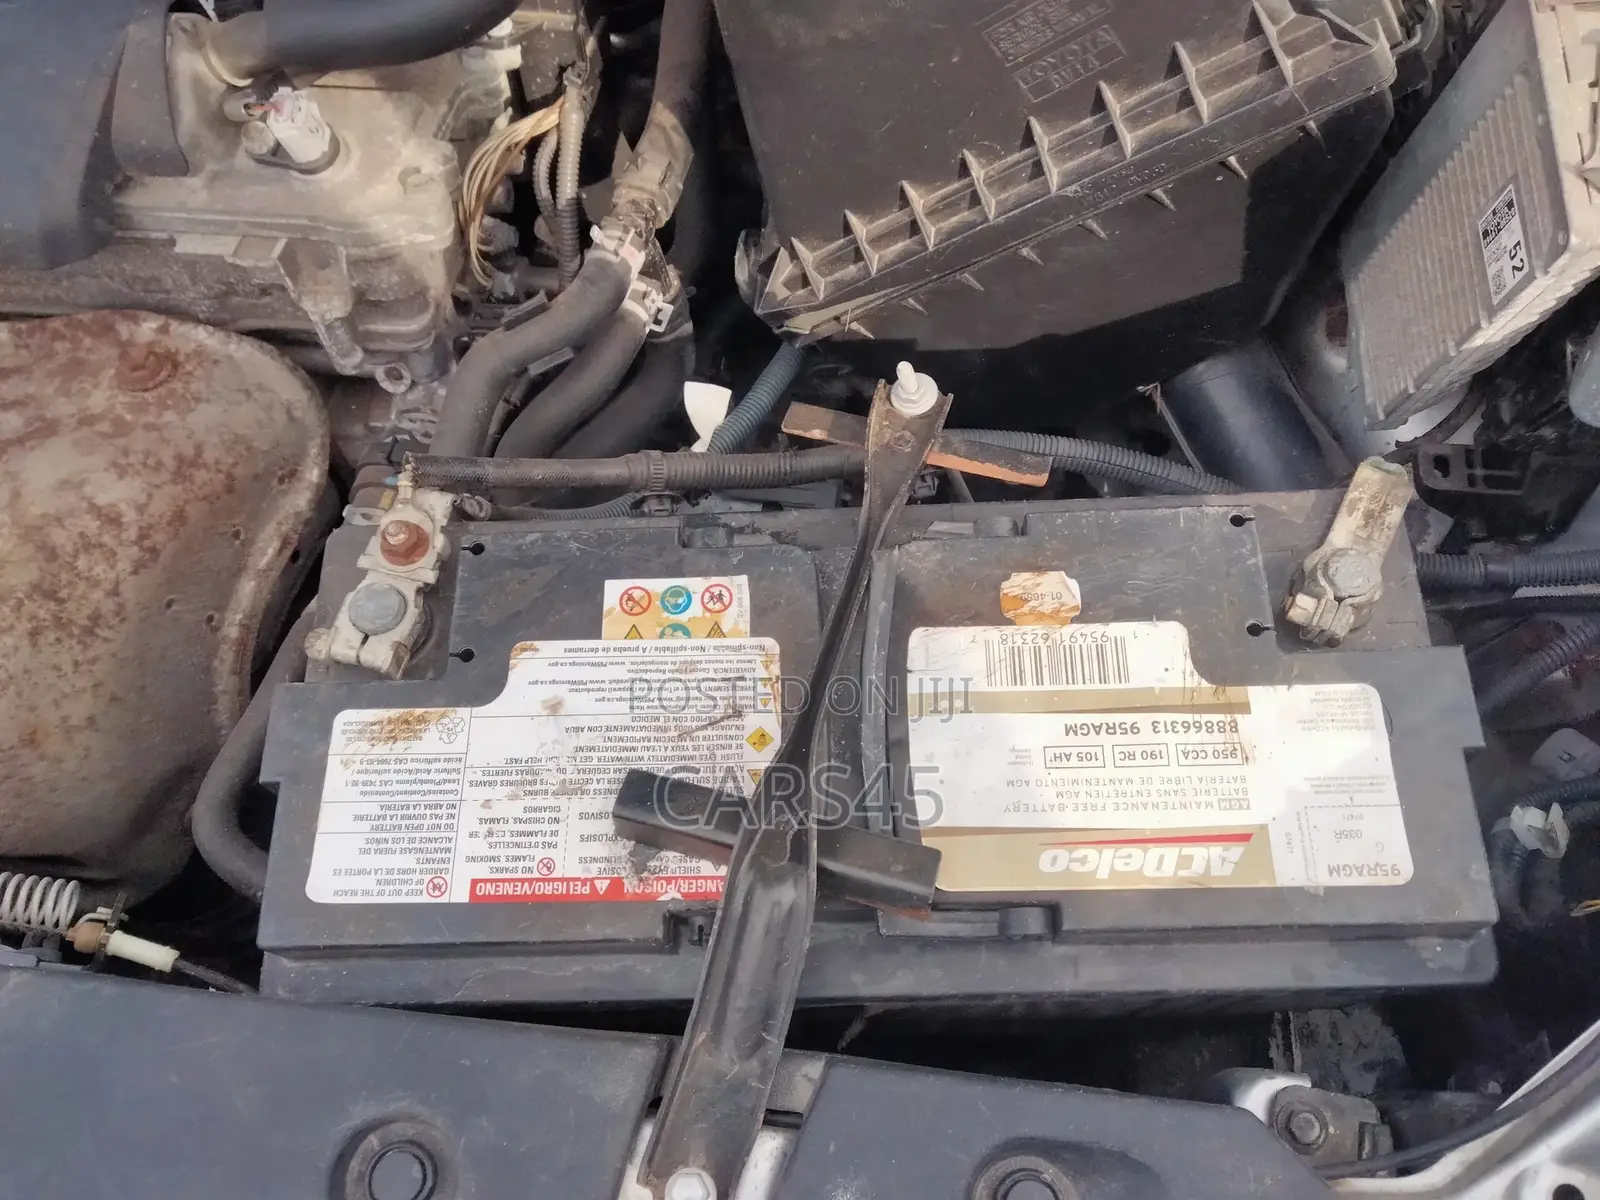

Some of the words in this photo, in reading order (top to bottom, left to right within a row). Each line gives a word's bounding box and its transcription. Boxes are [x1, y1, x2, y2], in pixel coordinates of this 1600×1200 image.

[1508, 239, 1525, 280] 52
[1000, 632, 1049, 646] 62318
[614, 646, 639, 654] prueba
[654, 644, 706, 653] Non-spillable
[564, 726, 586, 734] AGUA
[587, 725, 603, 734] CON
[1064, 721, 1141, 736] 95RAGM
[1151, 720, 1239, 734] 88866313
[601, 735, 652, 743] RAPIDEMENT.
[721, 753, 743, 761] FLUSH
[1076, 751, 1099, 762] 105
[1118, 751, 1136, 761] RC
[1141, 750, 1164, 760] 190
[1181, 749, 1208, 760] CCA
[1212, 749, 1238, 760] 950
[1006, 779, 1030, 788] AGM
[1035, 777, 1133, 787] MANTENIMIENTO
[1138, 776, 1152, 786] DE
[1158, 776, 1192, 786] LIBRE
[1055, 790, 1080, 799] AGM
[1085, 789, 1151, 799] ENTRETIEN
[1156, 788, 1186, 798] SANS
[1192, 787, 1248, 797] BATTERIE
[523, 805, 560, 813] CIGARROS
[1113, 800, 1214, 812] MAINTENANCE
[1219, 799, 1249, 809] AGM
[511, 816, 545, 824] CHISPAS,
[508, 830, 547, 838] FLAMMES,
[549, 830, 558, 838] DE
[1334, 829, 1362, 839] 035R
[502, 854, 535, 863] FLAMES,
[1038, 846, 1244, 879] ACDelco
[419, 867, 449, 875] GARDER
[488, 866, 519, 874] SPARKS,
[1328, 862, 1400, 878] 95RAGM
[476, 881, 591, 896] PELIGRO/VENENO
[624, 878, 724, 894] ANGER/POISON
[404, 888, 423, 897] KEEP
